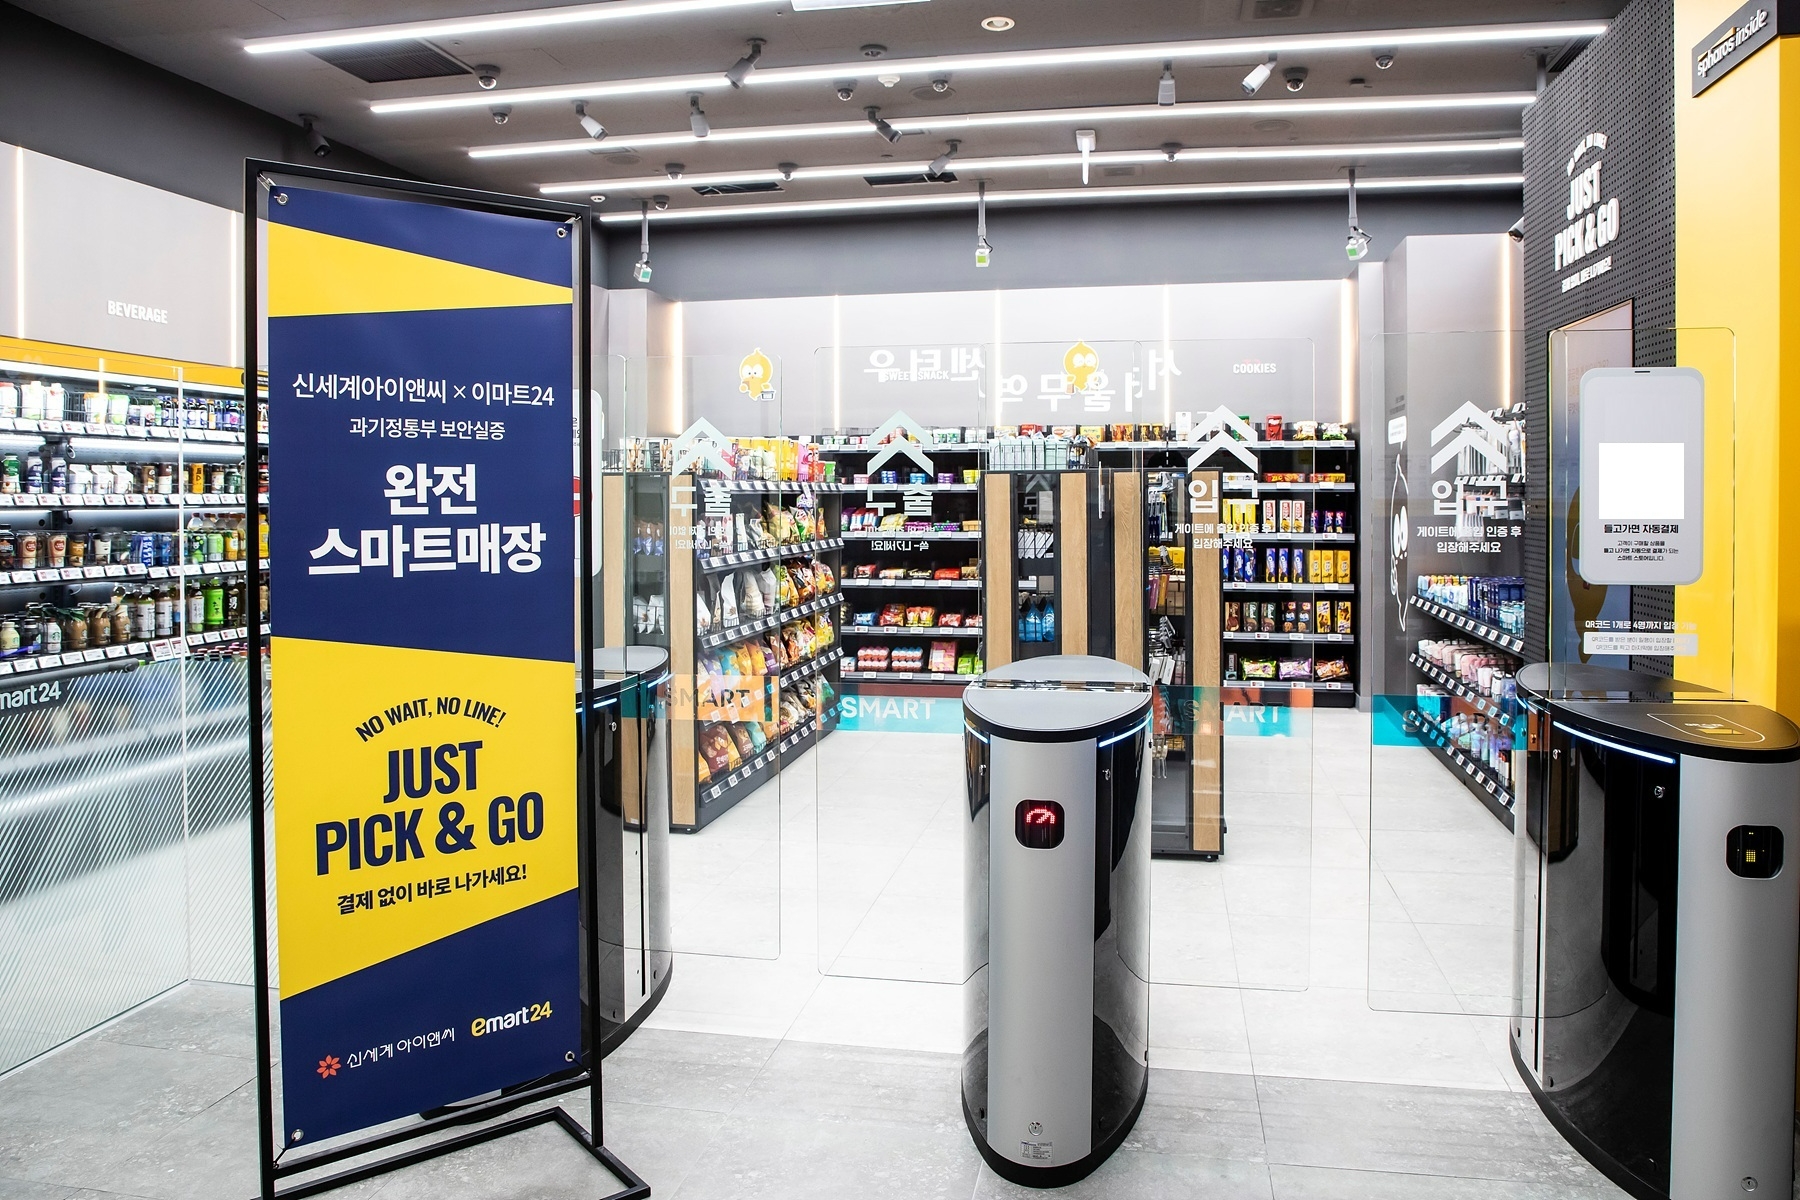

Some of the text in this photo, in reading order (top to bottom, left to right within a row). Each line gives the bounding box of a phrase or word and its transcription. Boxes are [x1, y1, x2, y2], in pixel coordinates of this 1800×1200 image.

[1697, 9, 1769, 78] spharos inside
[1566, 160, 1602, 220] JUST
[107, 300, 168, 324] BEVERAGE
[917, 370, 950, 381] SNACK
[1232, 363, 1277, 375] COOKIES
[292, 372, 446, 404] 신세계아이앤씨
[471, 380, 555, 407] 이마트24
[349, 417, 506, 441] 과기정통부 보안실증
[383, 463, 478, 516] 완전
[1187, 479, 1260, 514] 입구
[1431, 479, 1509, 516] 입구
[1174, 523, 1215, 535] 게이트에
[1193, 538, 1254, 550] 입장해주세요
[1416, 525, 1458, 538] 게이트에
[1486, 525, 1509, 538] 인증
[1510, 525, 1522, 538] 후
[1603, 523, 1680, 535] 들고가면 자동결제
[308, 522, 548, 578] 스마트매장
[1436, 541, 1502, 554] 입장해주세요
[1584, 620, 1611, 630] QR코드
[1612, 620, 1632, 630] 1개로
[1632, 620, 1662, 631] 4명까지
[355, 696, 507, 743] NO WAIT, NO LINE!
[841, 696, 937, 720] SMART
[383, 740, 483, 804] JUST
[315, 791, 544, 876] PICK & GO
[337, 864, 528, 916] 결제 없이 바로 나가세요!
[471, 1001, 553, 1037] emart24
[346, 1027, 456, 1069] 신세계 아이앤씨
